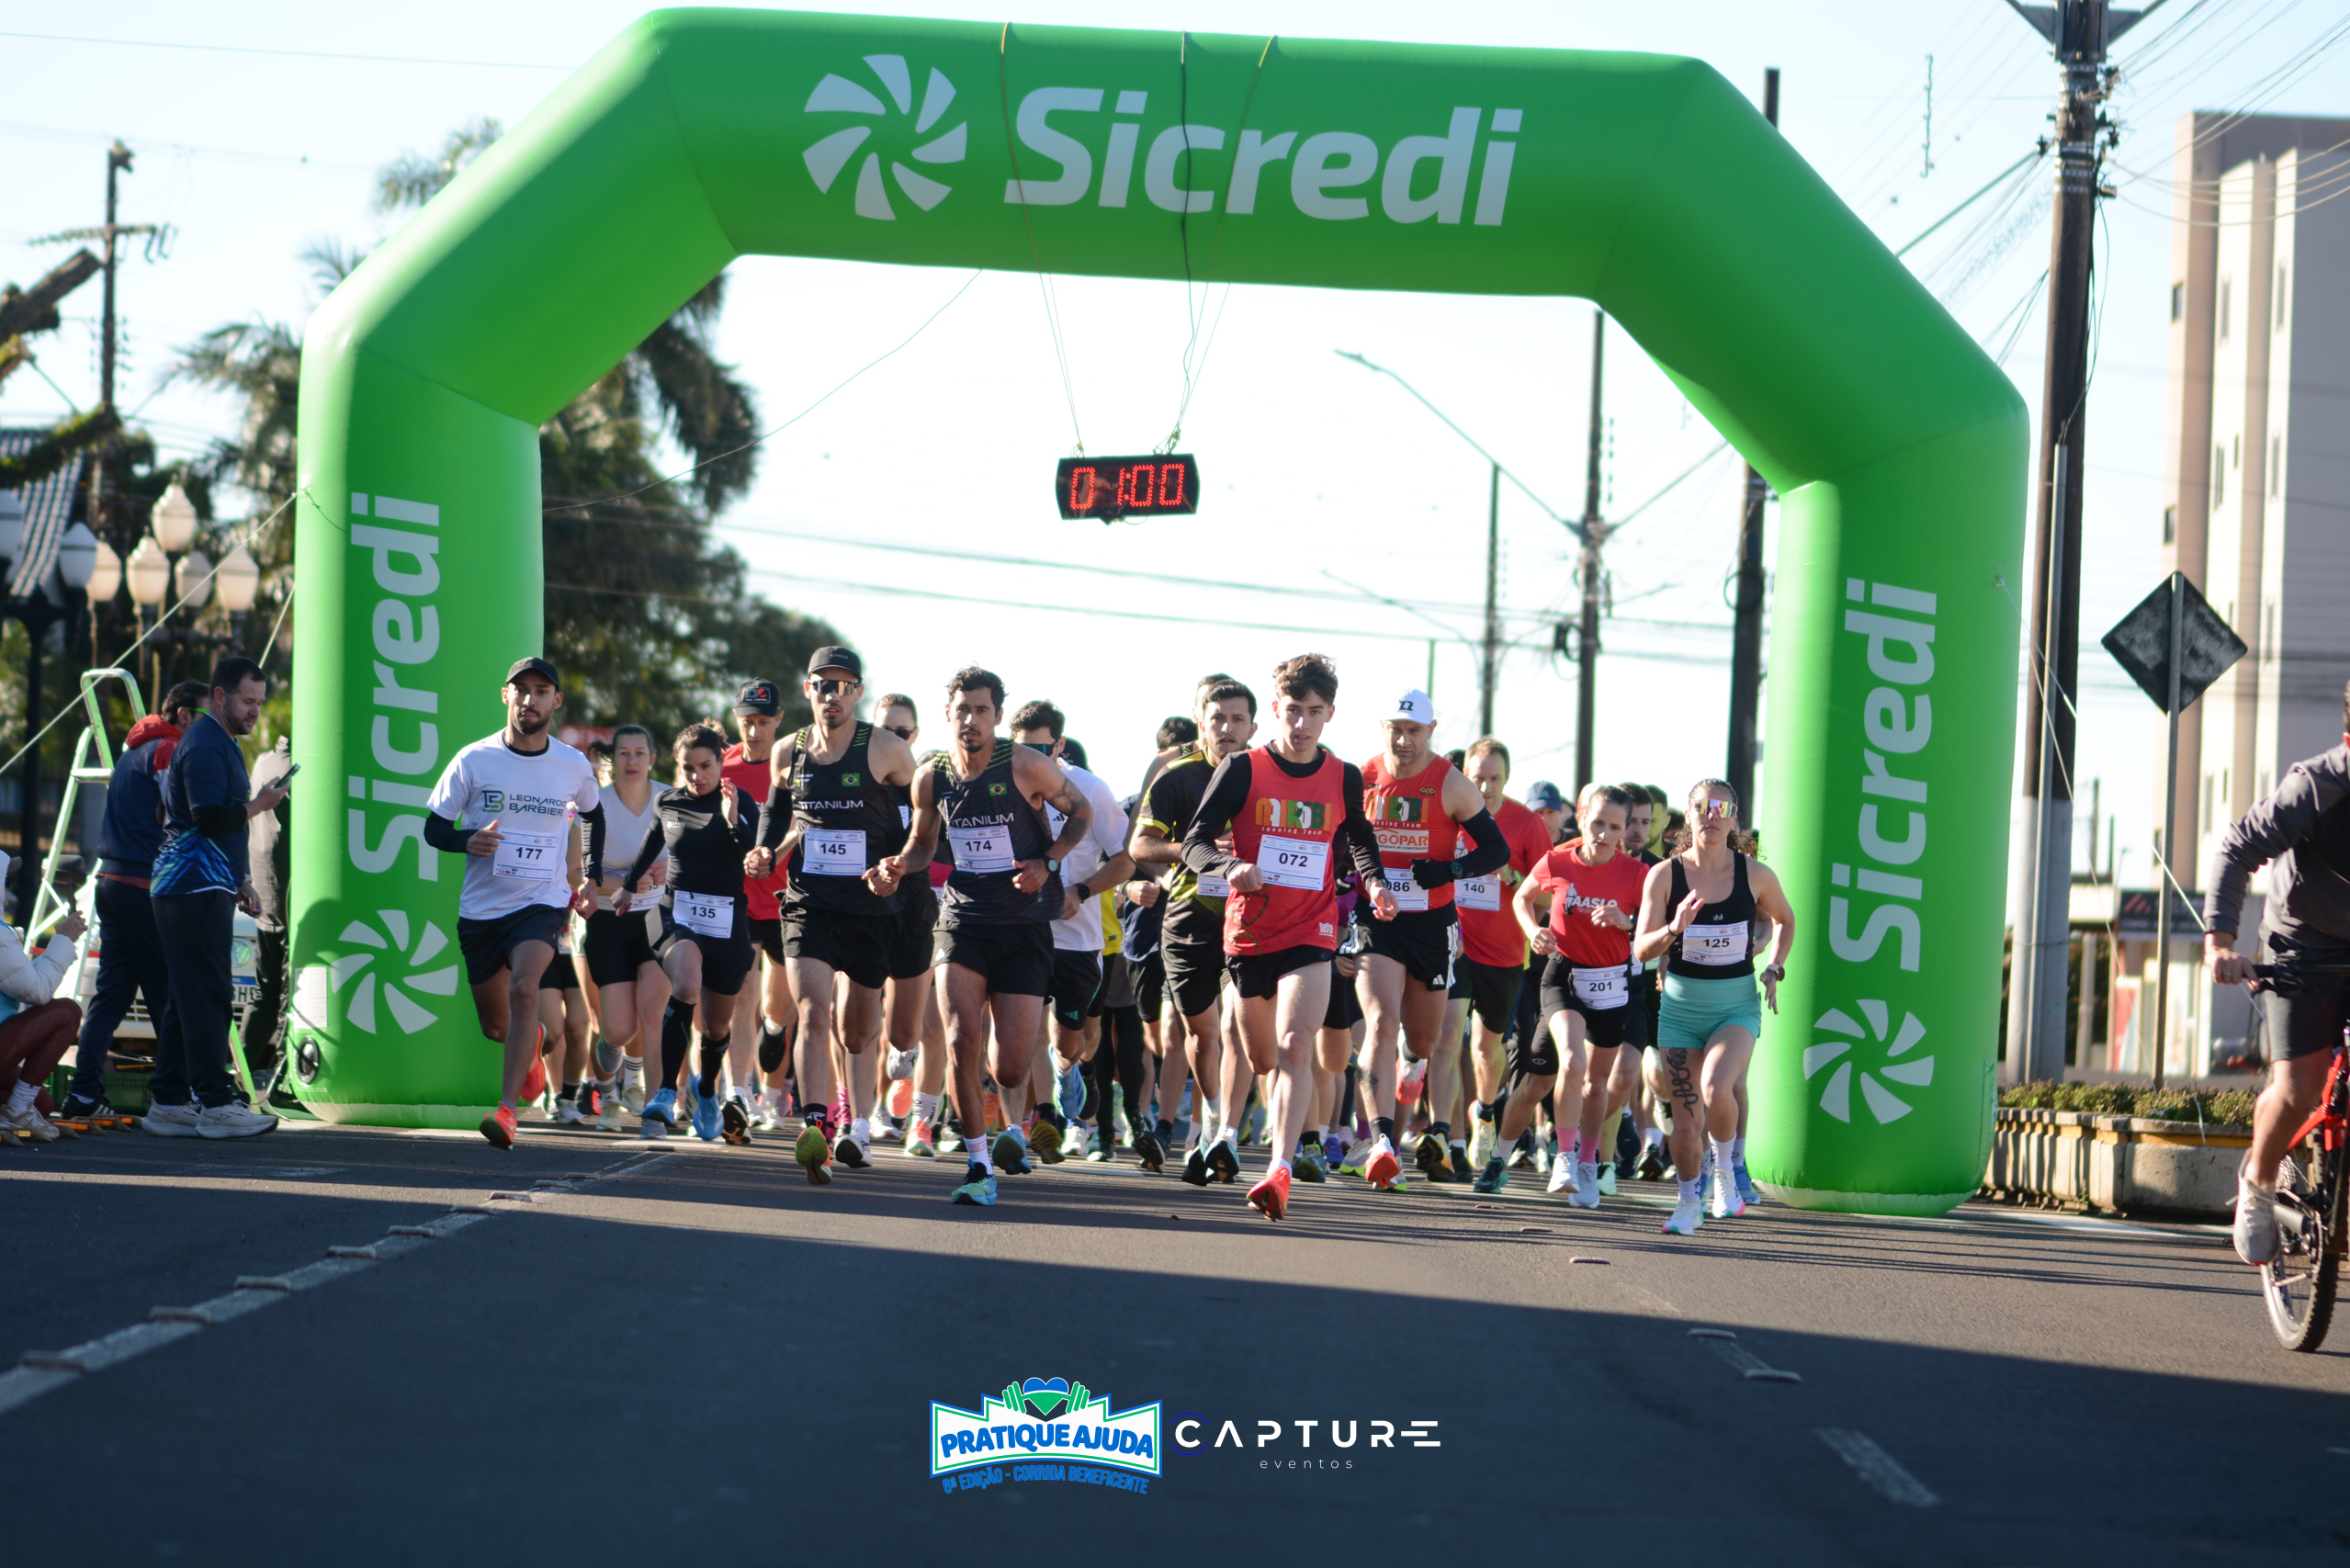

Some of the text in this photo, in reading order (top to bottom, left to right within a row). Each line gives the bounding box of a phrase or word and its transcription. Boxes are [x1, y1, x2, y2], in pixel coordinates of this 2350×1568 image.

[1004, 85, 1524, 227] Sicredi
[1071, 464, 1184, 509] 01:00
[348, 492, 442, 882] Sicredi
[1828, 577, 1938, 973] Sicredi
[509, 794, 567, 807] LEONARDO
[797, 799, 864, 809] TITANIUM
[966, 840, 992, 852] 174
[1375, 833, 1429, 846] GOPAR
[515, 846, 543, 860] 177
[820, 843, 846, 855] 145
[1279, 852, 1308, 867] 072
[1463, 883, 1485, 893] 140
[691, 906, 716, 919] 135
[1702, 937, 1730, 948] 125
[1589, 981, 1612, 992] 201
